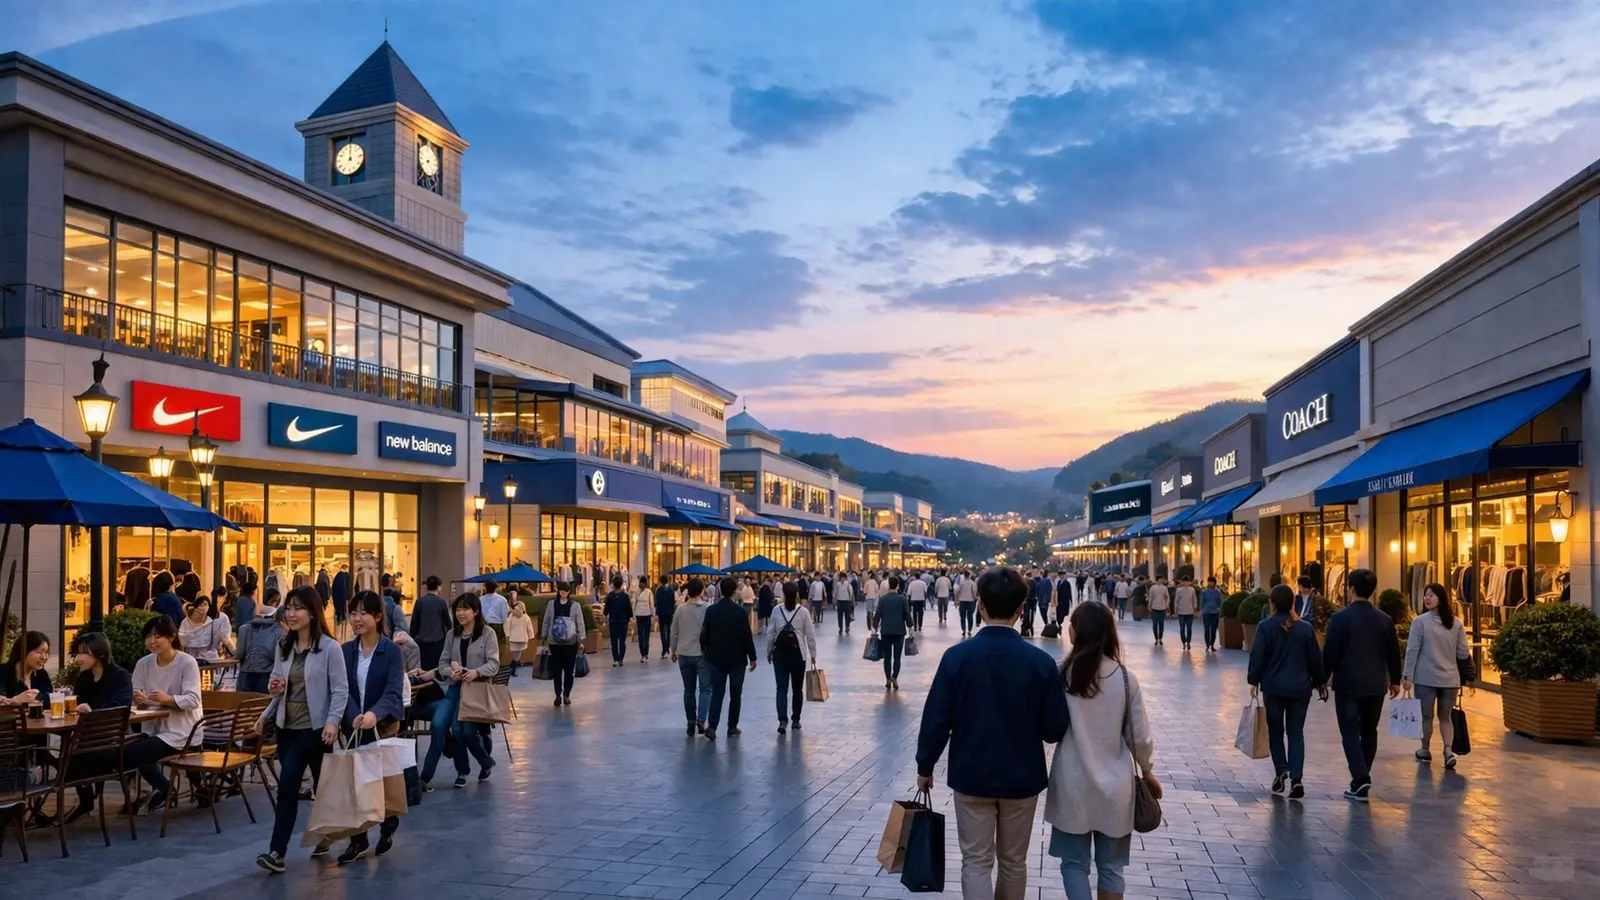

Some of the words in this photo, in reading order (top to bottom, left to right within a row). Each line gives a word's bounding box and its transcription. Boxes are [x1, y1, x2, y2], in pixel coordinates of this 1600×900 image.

[1282, 393, 1328, 440] COACH
[386, 435, 410, 449] new
[411, 435, 452, 456] balance
